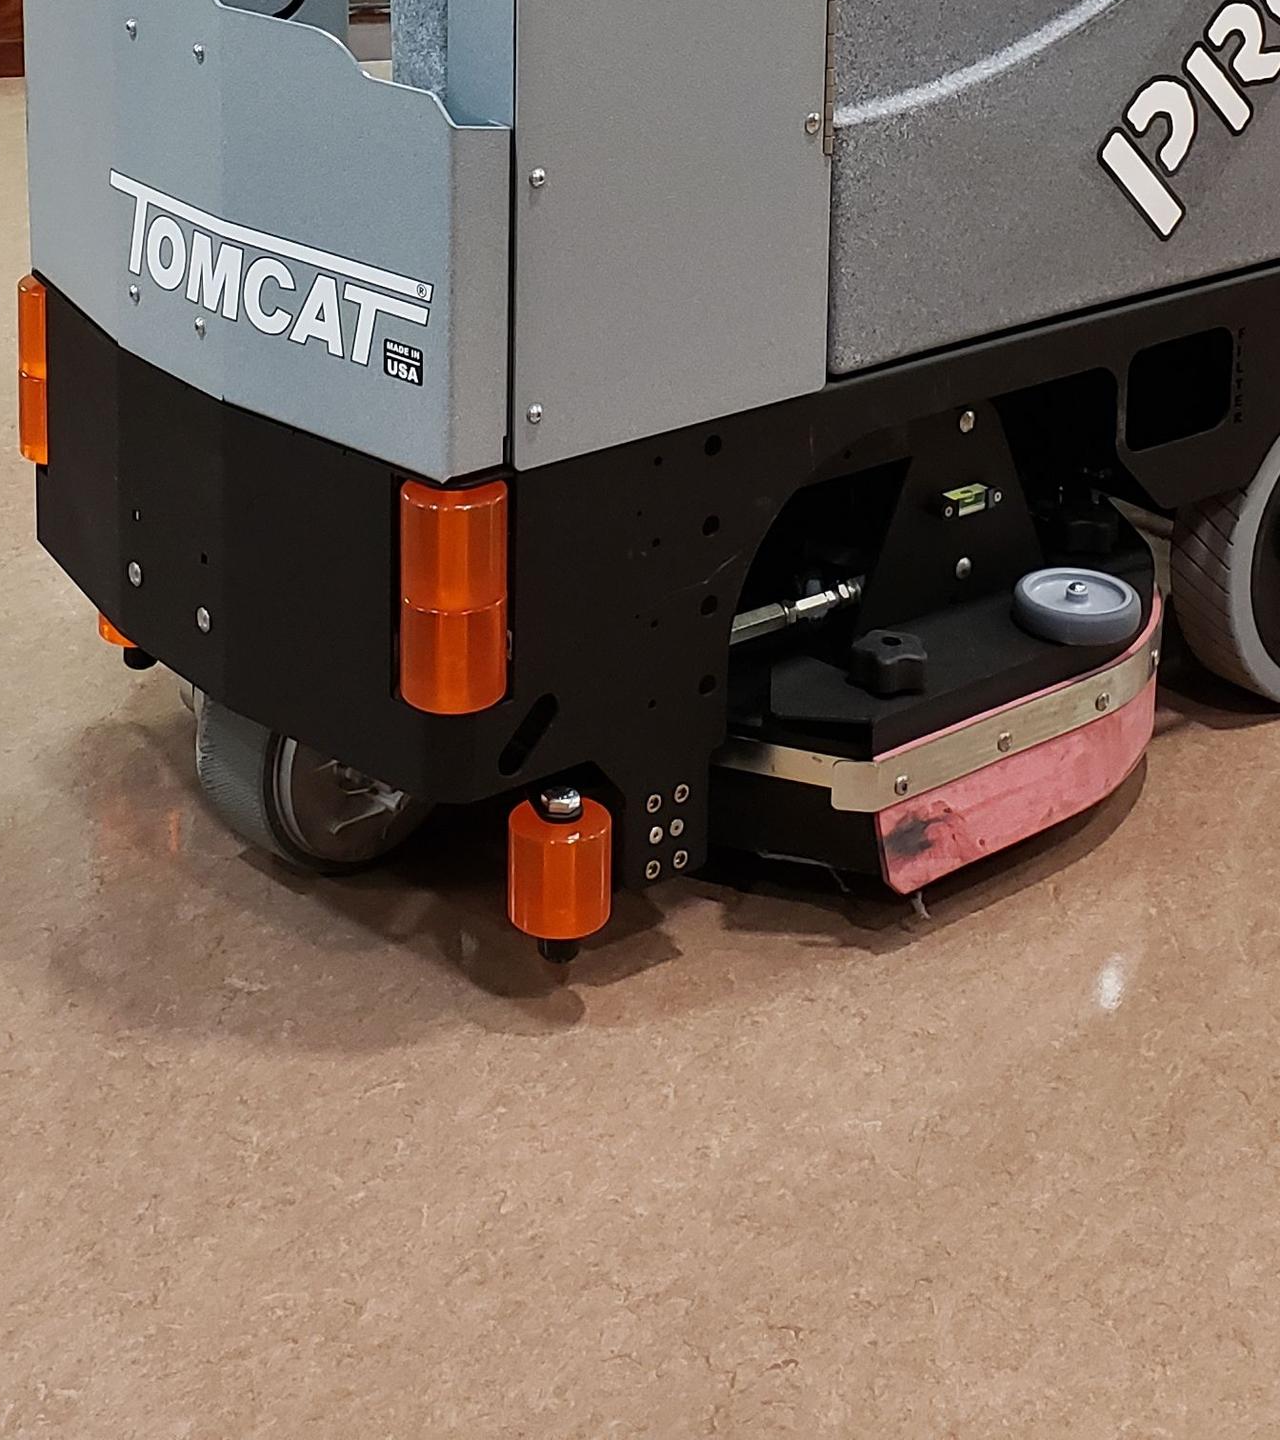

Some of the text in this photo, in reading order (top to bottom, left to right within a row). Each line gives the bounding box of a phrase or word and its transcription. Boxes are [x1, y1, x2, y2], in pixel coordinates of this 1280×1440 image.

[109, 168, 434, 367] TOMCAT
[386, 341, 420, 360] MADE IN
[387, 358, 419, 383] USA
[1232, 326, 1246, 424] FILTER
